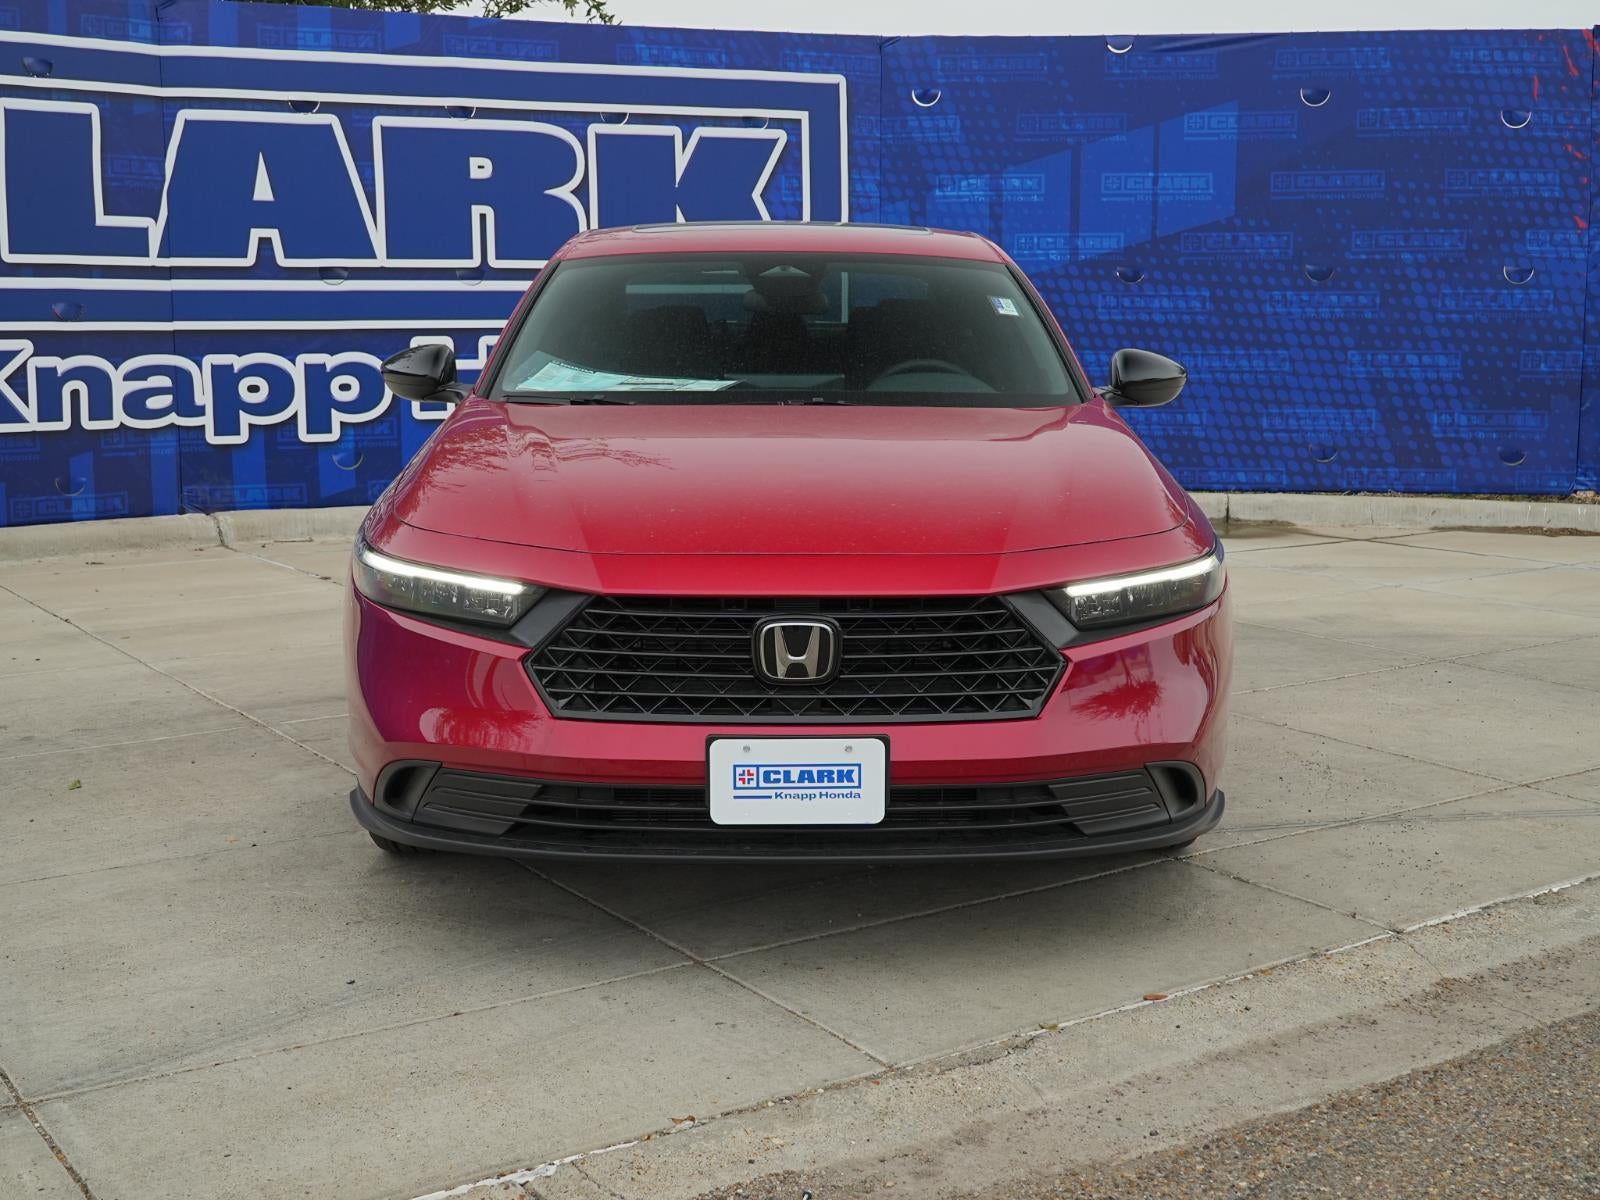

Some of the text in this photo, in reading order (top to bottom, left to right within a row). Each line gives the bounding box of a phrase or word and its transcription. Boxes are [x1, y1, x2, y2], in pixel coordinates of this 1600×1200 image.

[1126, 176, 1209, 190] CLARK
[763, 769, 855, 784] CLARK
[775, 790, 861, 801] Knapp Honda
